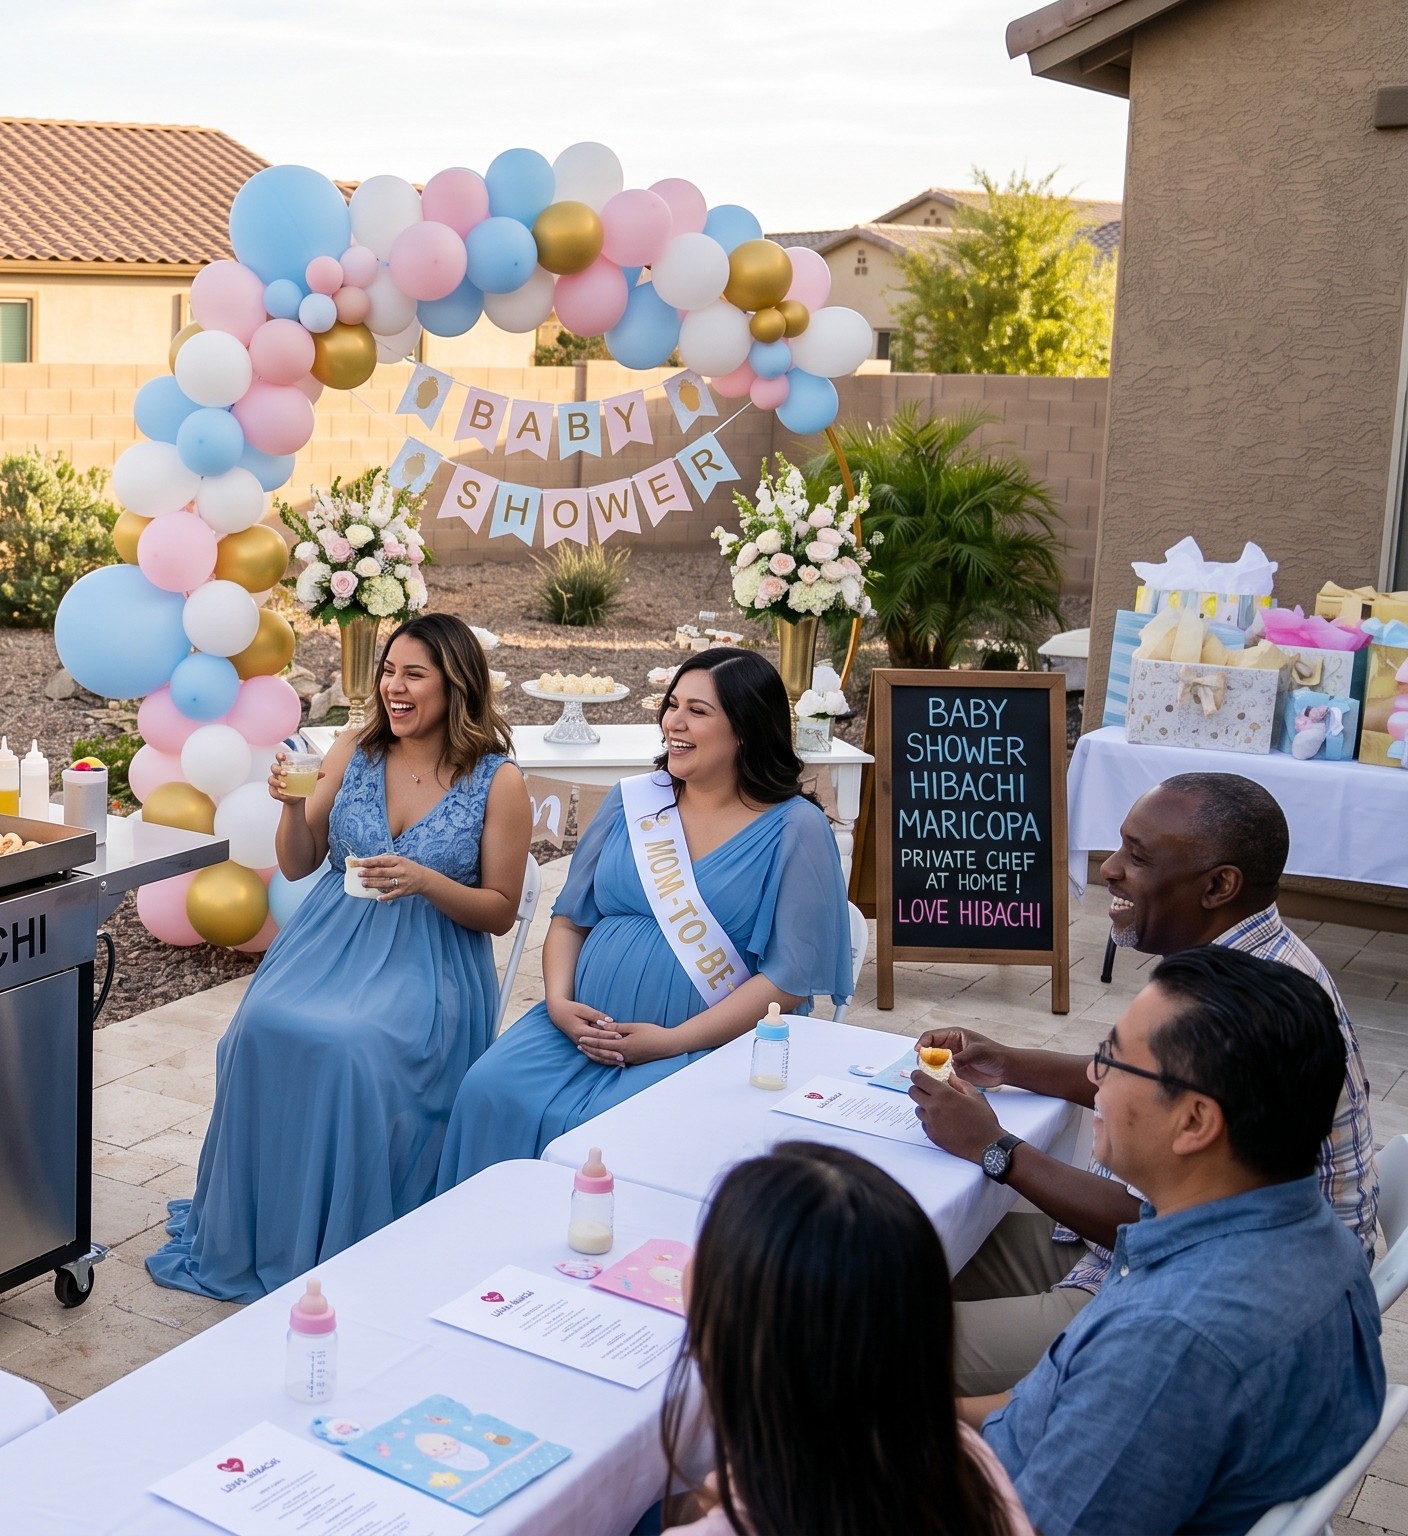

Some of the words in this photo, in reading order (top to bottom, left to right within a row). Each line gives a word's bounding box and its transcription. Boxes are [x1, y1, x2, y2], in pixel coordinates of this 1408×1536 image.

[469, 398, 636, 442] BABY
[455, 448, 724, 529] SHOWER
[928, 697, 1008, 730] BABY
[906, 732, 1027, 766] SHOWER
[909, 770, 1025, 803] HIBACHI
[898, 809, 1042, 842] MARICOPA
[901, 848, 977, 869] PRIVATE
[986, 851, 1036, 871] CHEF
[925, 872, 950, 890] AT
[958, 873, 1007, 892] HOME
[644, 838, 736, 991] MOM-TO-BE
[898, 899, 949, 924] LOVE
[959, 900, 1041, 928] HIBACHI
